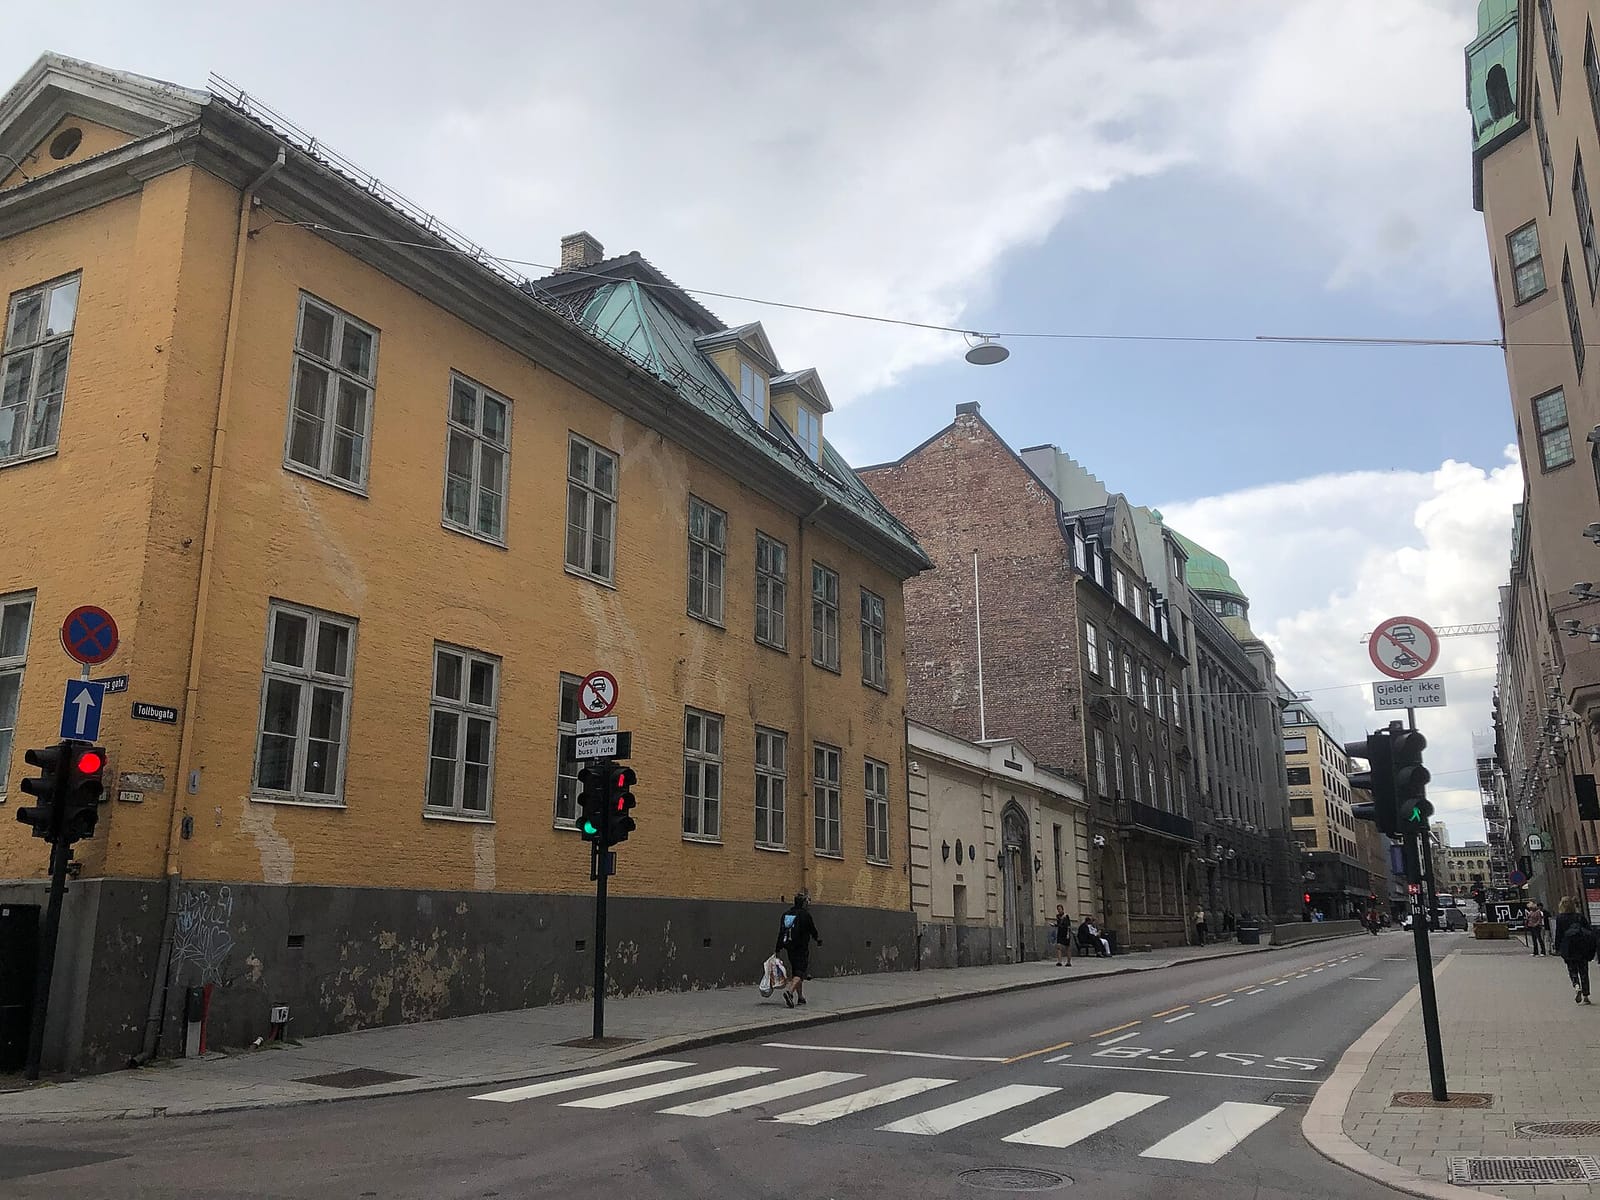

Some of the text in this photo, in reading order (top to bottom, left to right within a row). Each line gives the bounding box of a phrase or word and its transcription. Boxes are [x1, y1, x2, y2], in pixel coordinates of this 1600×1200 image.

[112, 678, 124, 691] gate
[1377, 682, 1441, 696] Gjelder ikke
[1379, 697, 1404, 706] buss
[1418, 695, 1440, 703] rute
[138, 705, 174, 720] Tollbugata
[578, 739, 599, 747] Gjelder
[1091, 1046, 1326, 1071] BUSS
